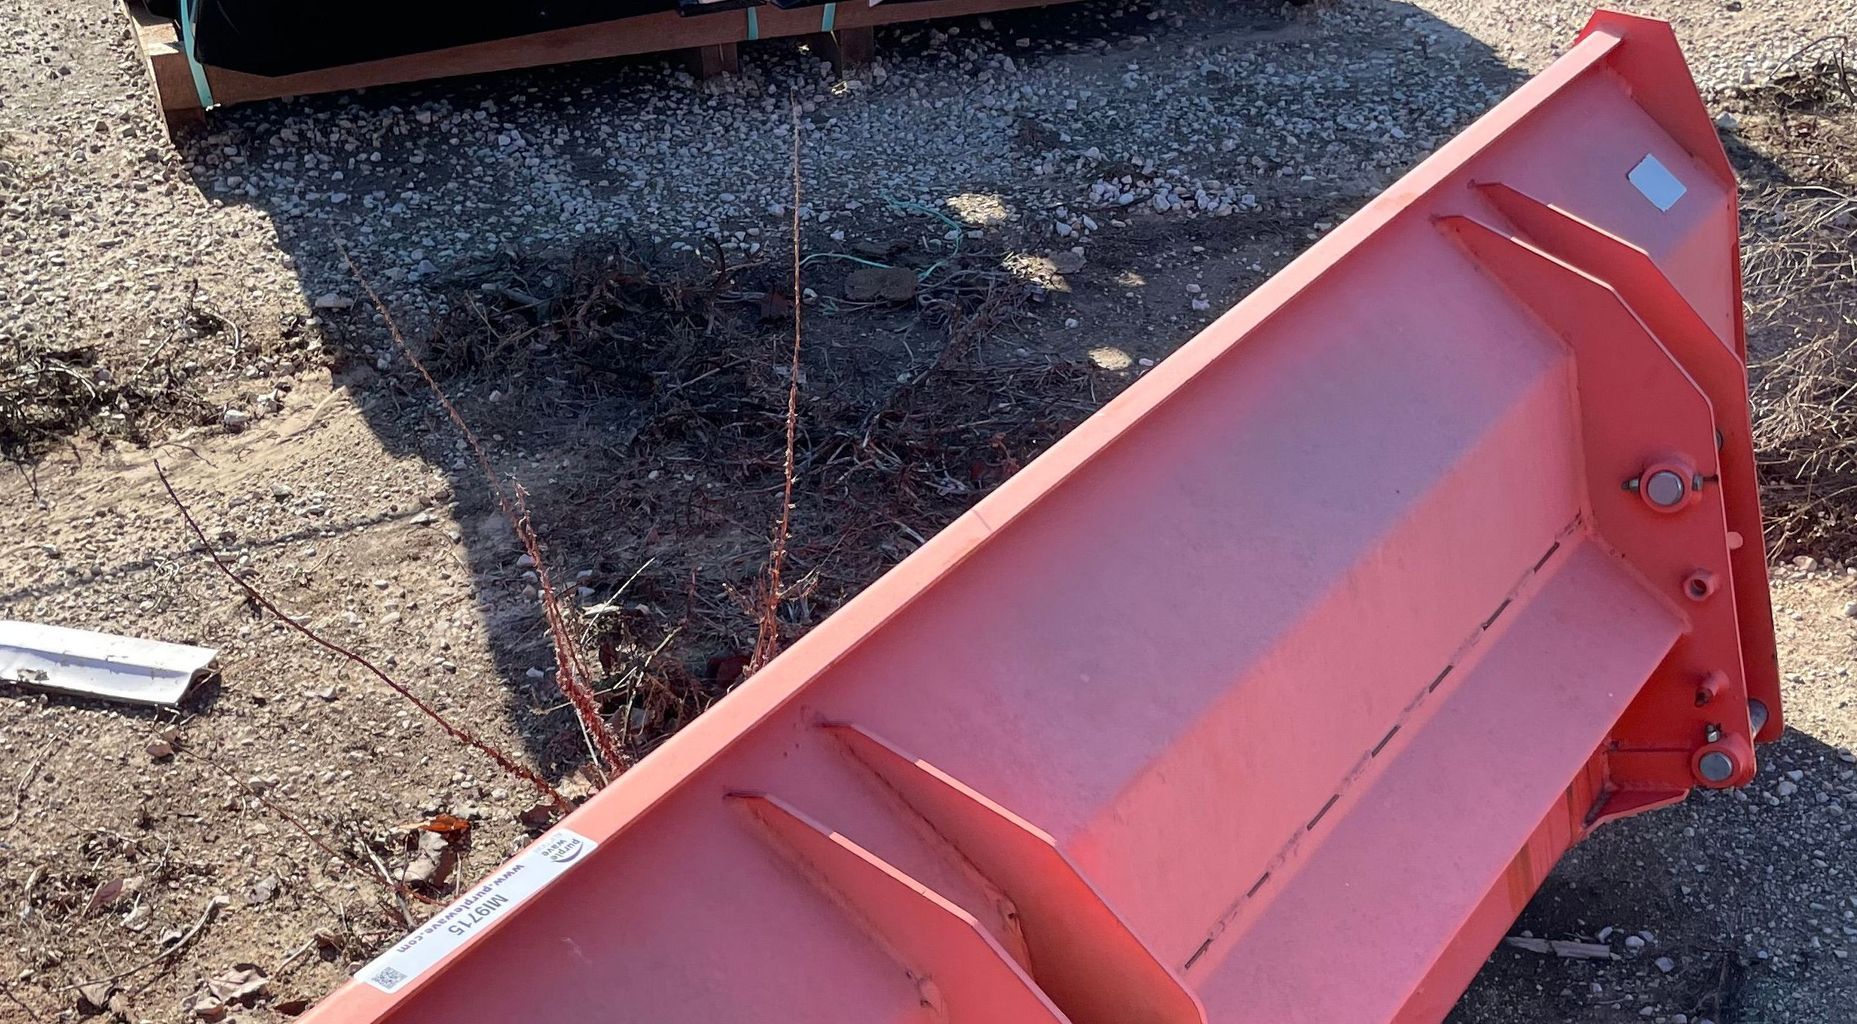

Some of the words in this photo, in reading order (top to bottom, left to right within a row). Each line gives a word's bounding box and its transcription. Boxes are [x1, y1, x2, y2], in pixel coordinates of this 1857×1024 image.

[541, 839, 567, 857] wave
[550, 838, 580, 861] purple
[397, 864, 525, 953] www.purplewave.com
[448, 894, 509, 936] MI9715
